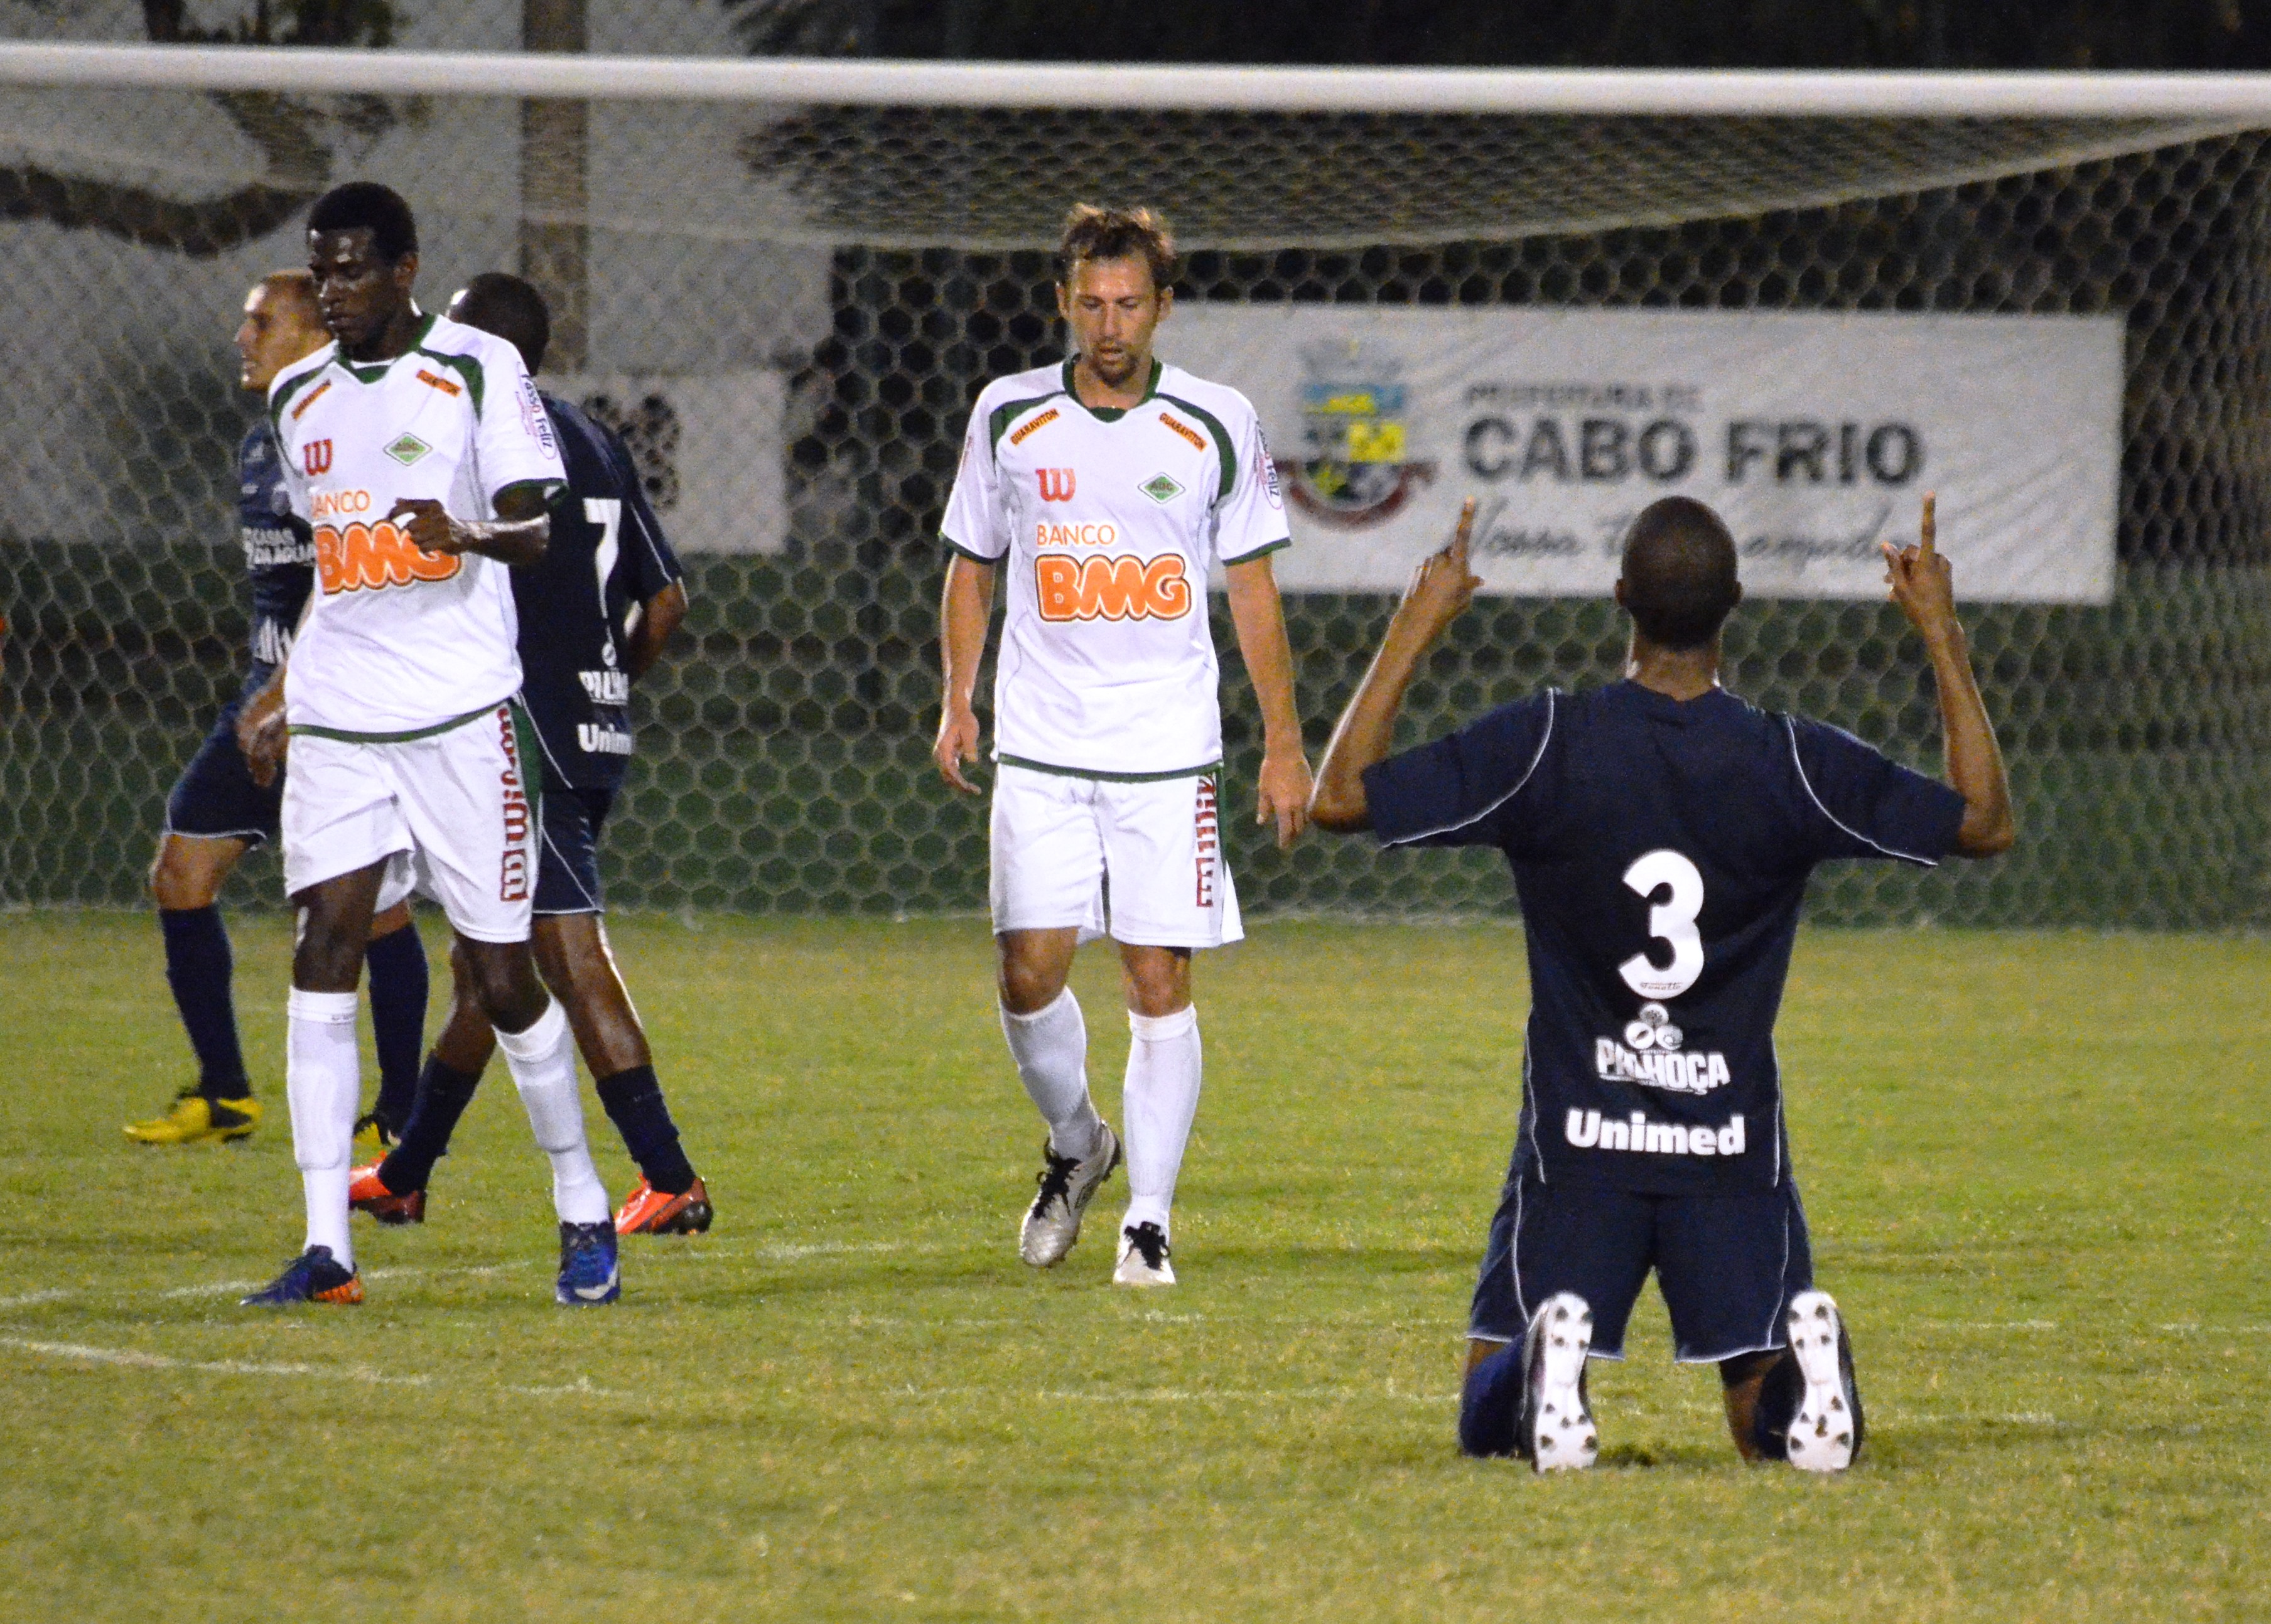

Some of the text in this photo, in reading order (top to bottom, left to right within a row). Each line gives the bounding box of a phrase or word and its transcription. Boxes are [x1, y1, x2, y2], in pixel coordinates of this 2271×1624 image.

[1010, 408, 1059, 446] GUARAVITON
[1464, 417, 1924, 486] CABO FRIO
[312, 489, 370, 517] ANCO
[583, 498, 622, 618] 7
[1037, 525, 1116, 546] BANCO
[1035, 554, 1190, 622] BMG
[1617, 847, 1705, 999] 3
[1565, 1108, 1746, 1156] Unimed
